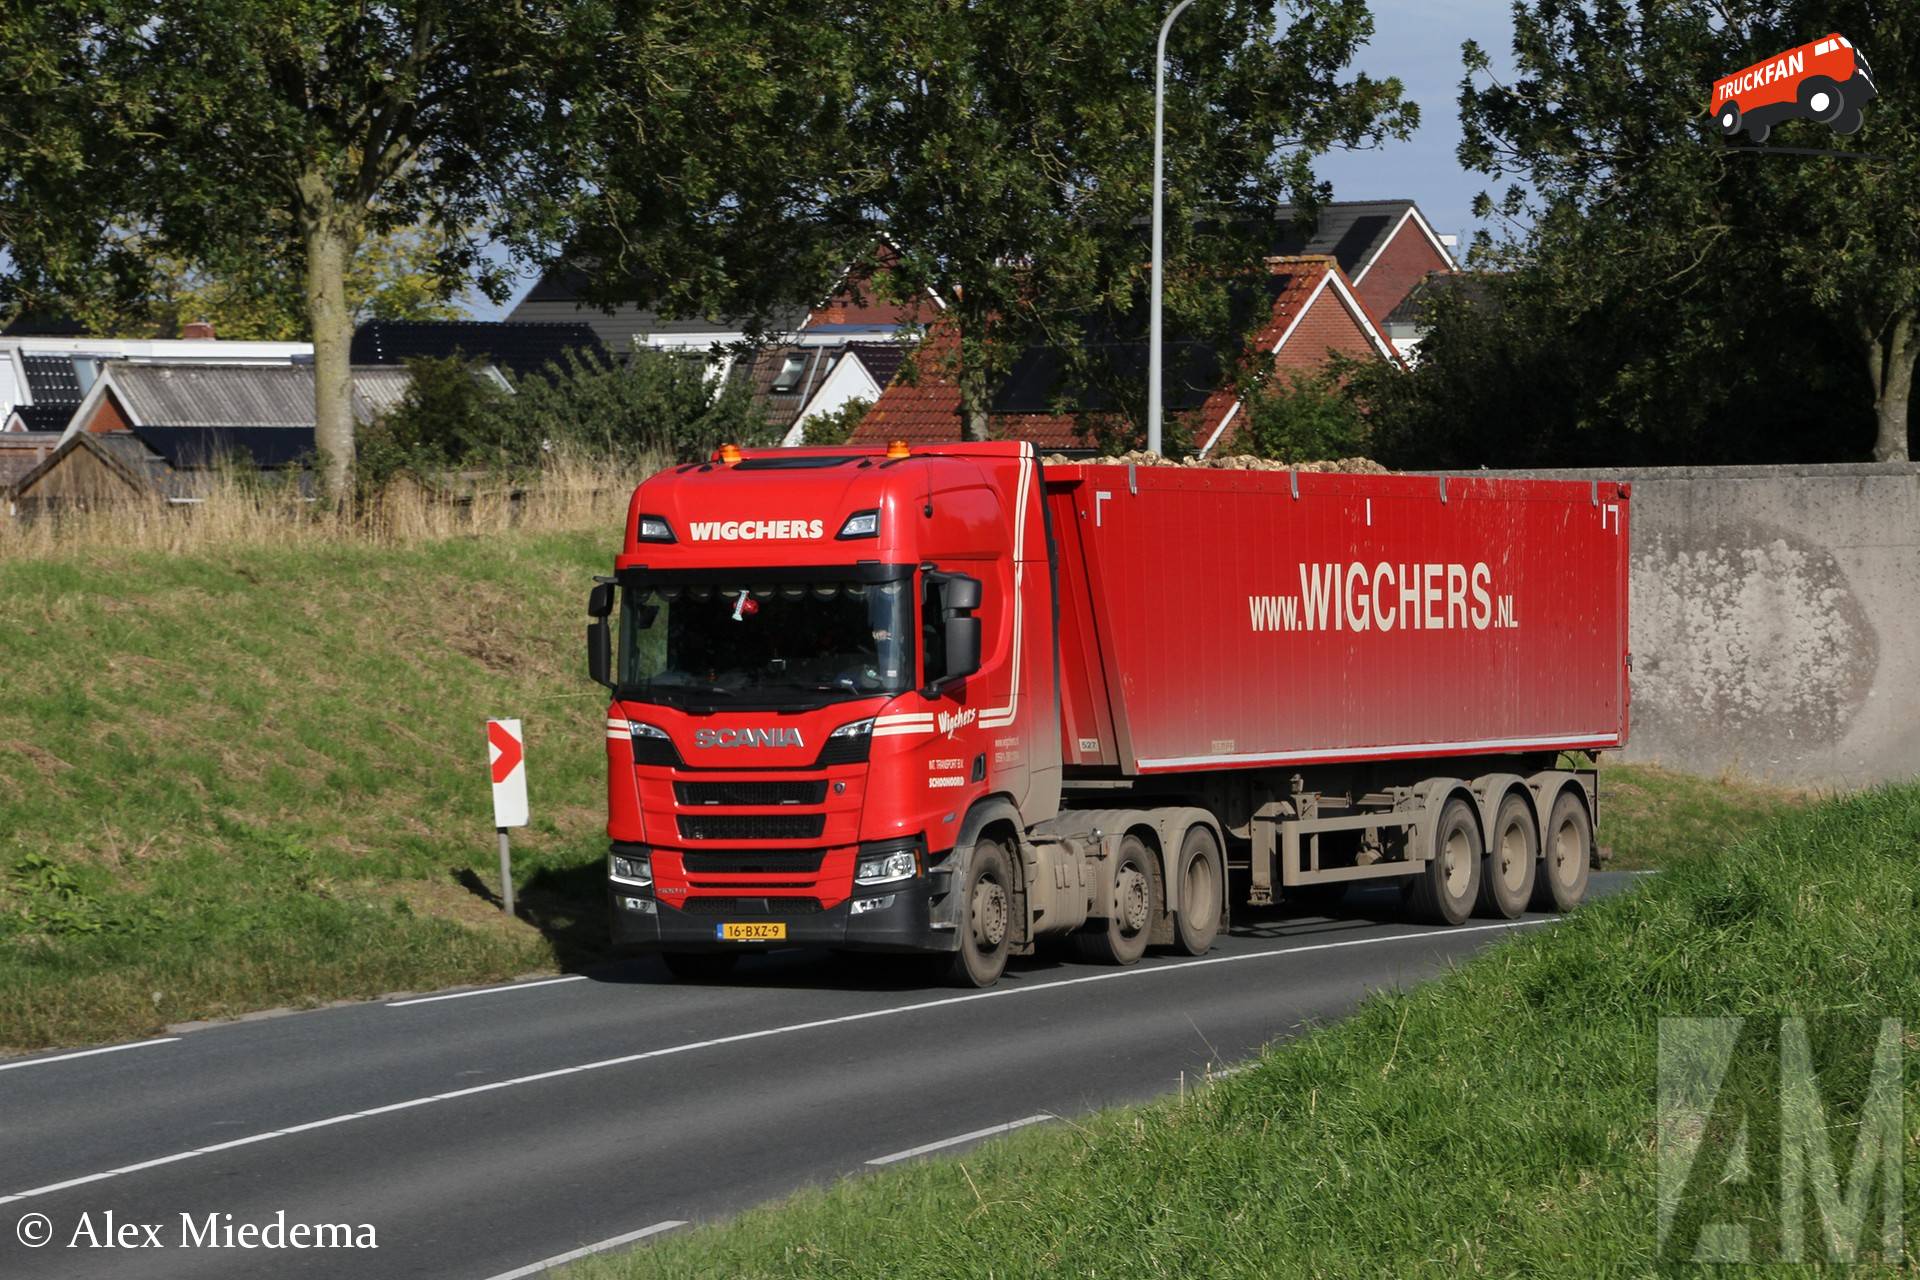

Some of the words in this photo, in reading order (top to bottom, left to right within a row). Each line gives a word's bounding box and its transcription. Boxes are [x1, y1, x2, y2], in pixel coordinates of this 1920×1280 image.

[689, 519, 824, 541] WIGCHERS
[938, 706, 976, 740] Wigchers
[695, 727, 804, 749] SCANIA
[1081, 741, 1097, 750] 527
[928, 775, 965, 789] SCHOONOORD
[728, 925, 780, 938] 16-BXZ-9
